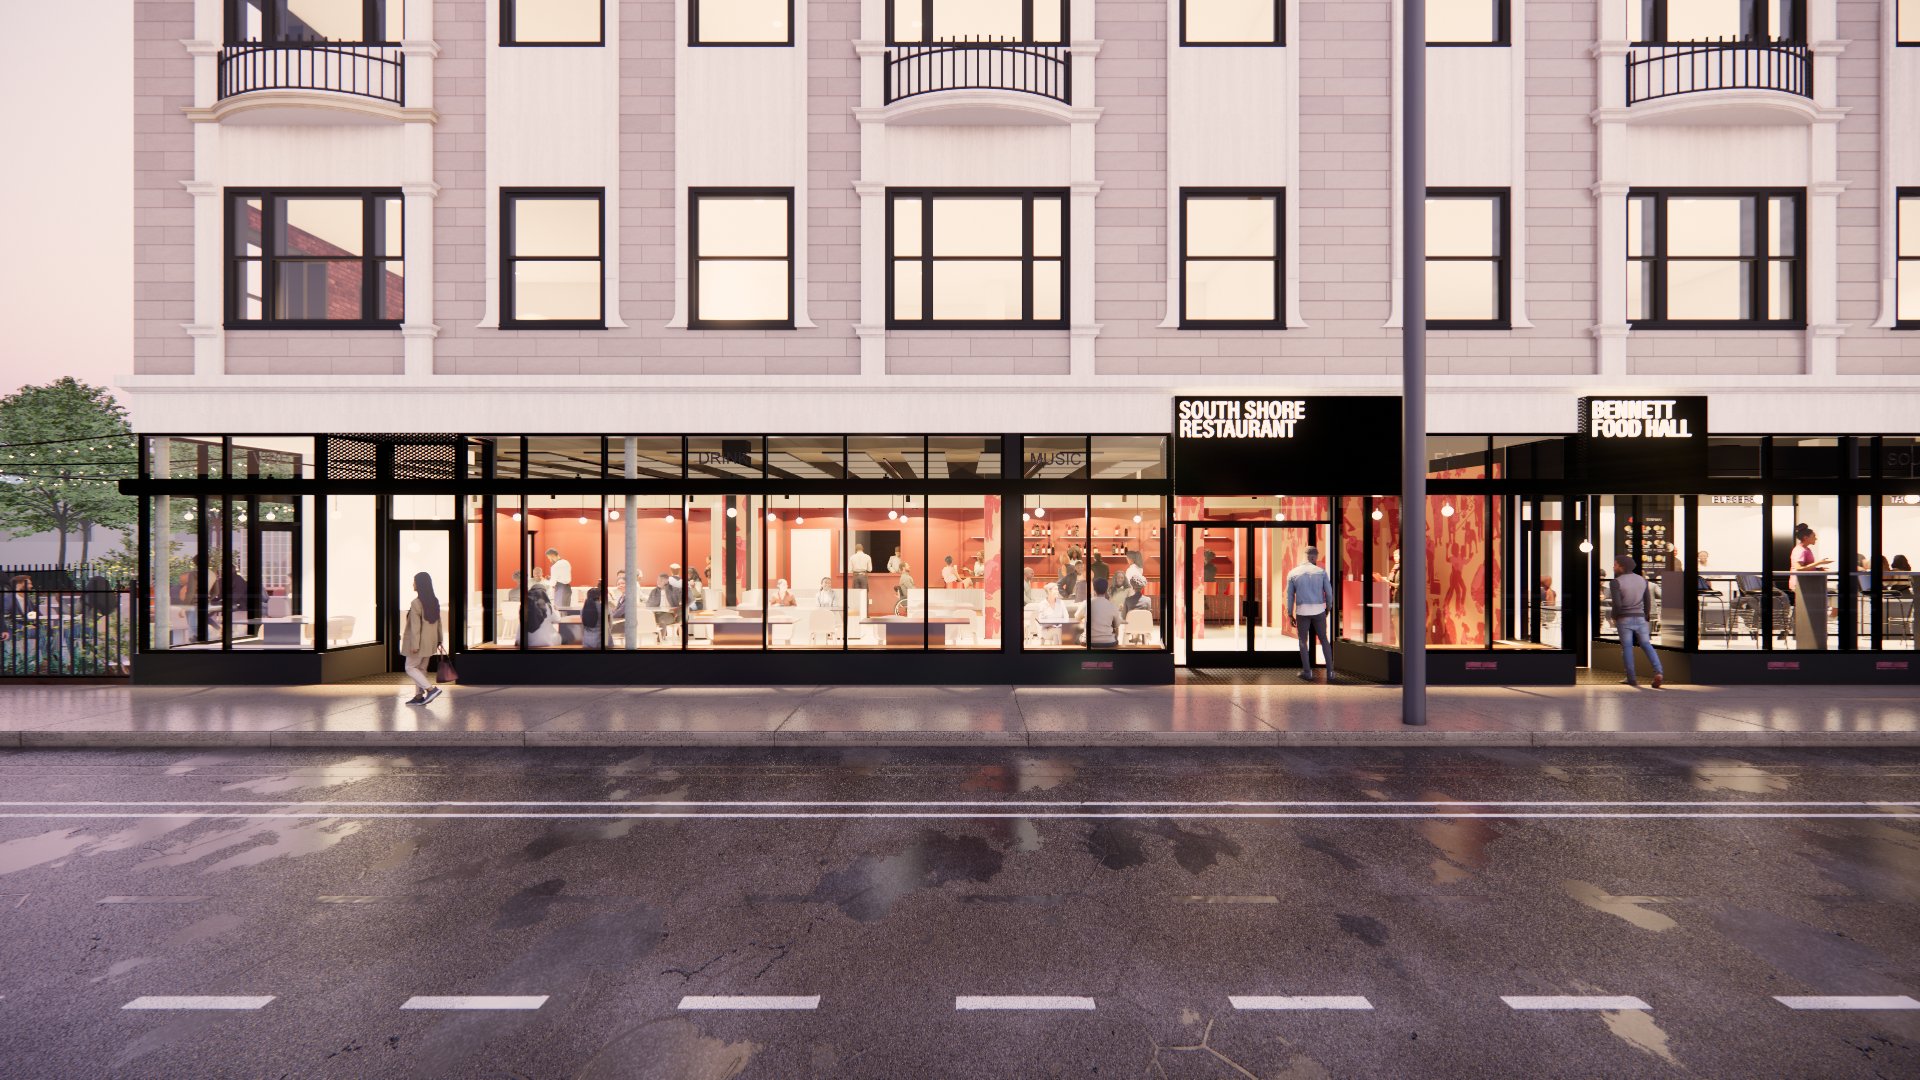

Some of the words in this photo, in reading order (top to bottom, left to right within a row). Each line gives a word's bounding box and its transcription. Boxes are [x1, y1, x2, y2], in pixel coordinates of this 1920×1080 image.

[1179, 400, 1240, 420] SOUTH
[1244, 400, 1306, 420] SHORE
[1591, 400, 1677, 420] BENNETT
[1179, 419, 1298, 438] RESTAURANT
[1591, 419, 1643, 438] FOOD
[1644, 419, 1693, 438] HALL
[1030, 452, 1082, 466] MUSIC
